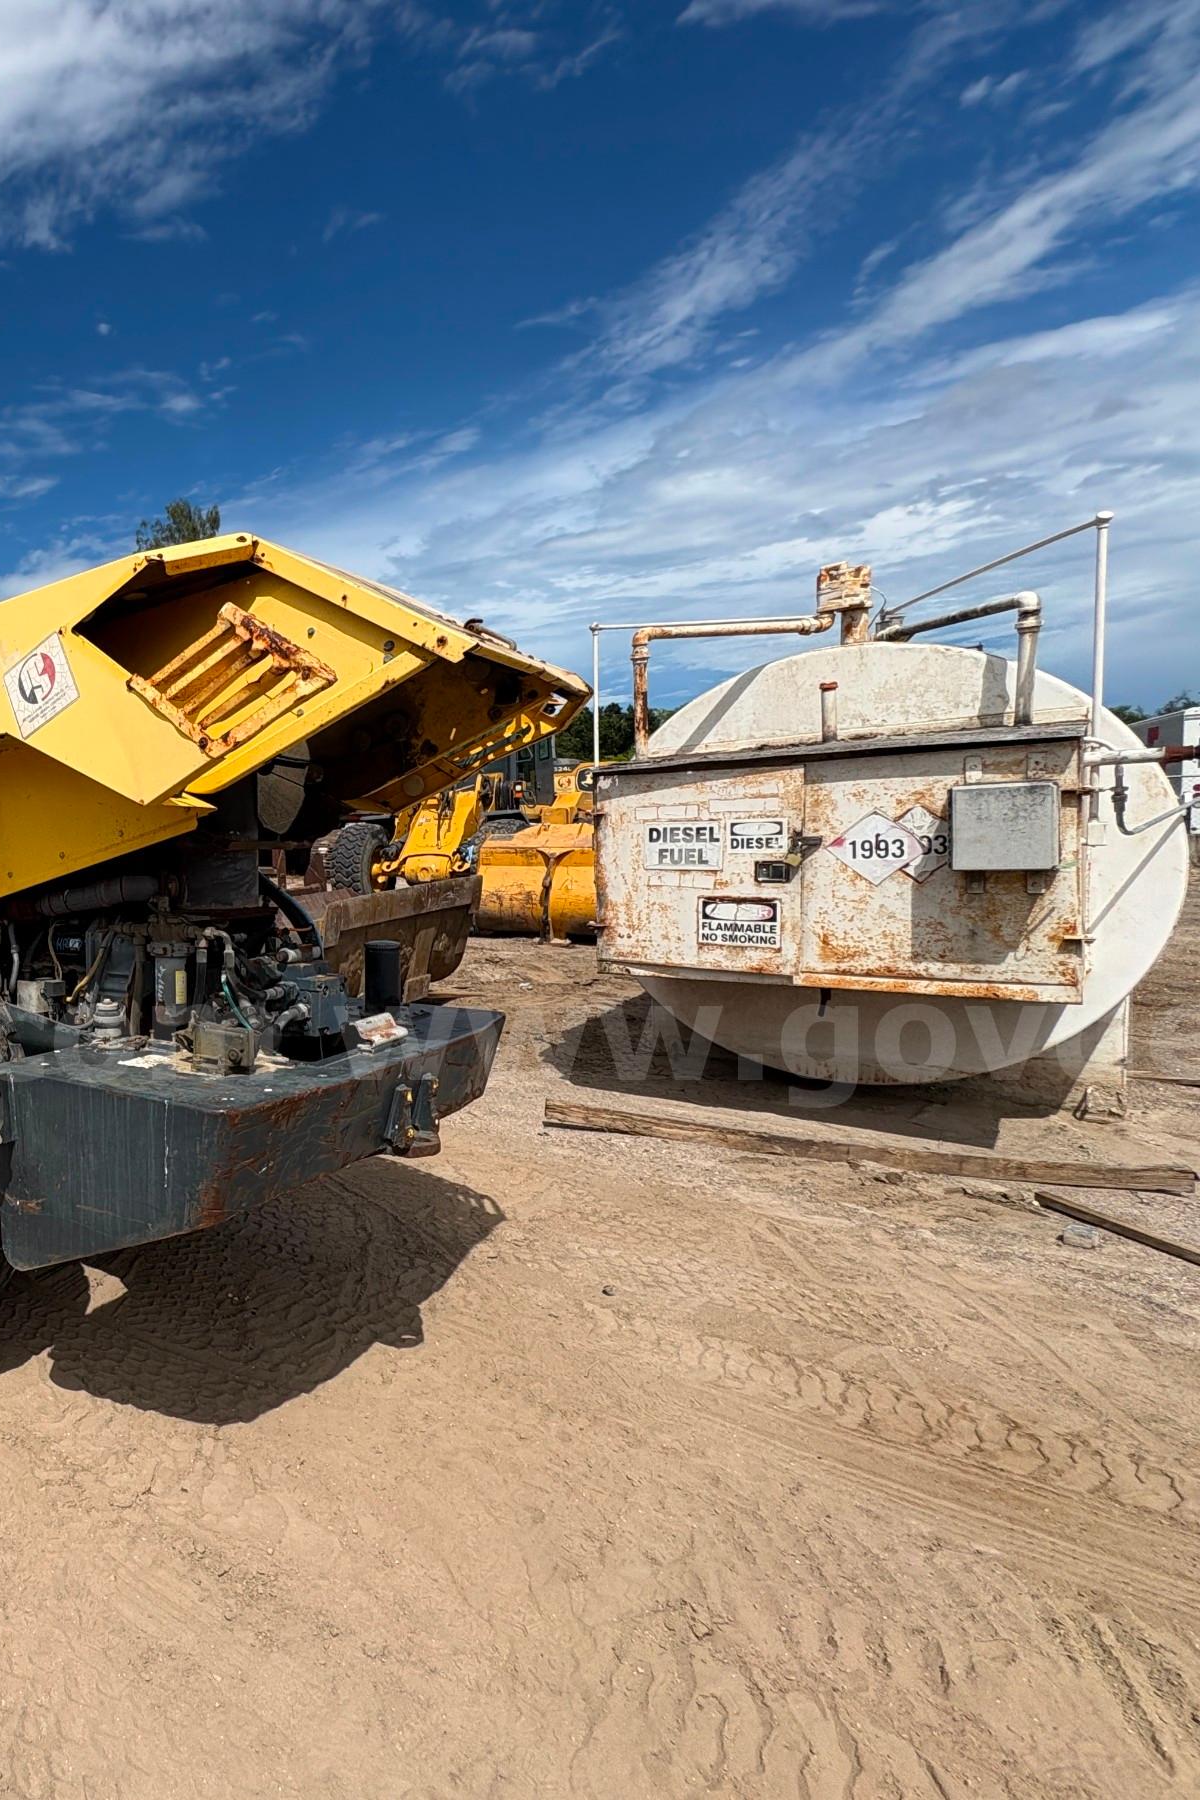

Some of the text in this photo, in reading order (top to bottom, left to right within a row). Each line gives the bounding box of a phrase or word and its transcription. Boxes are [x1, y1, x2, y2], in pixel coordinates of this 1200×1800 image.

[648, 827, 720, 843] DIESEL
[658, 848, 709, 865] FUEL
[848, 839, 905, 860] 1993
[701, 921, 777, 934] FLAMMABLE
[701, 932, 777, 945] NO SMOKING
